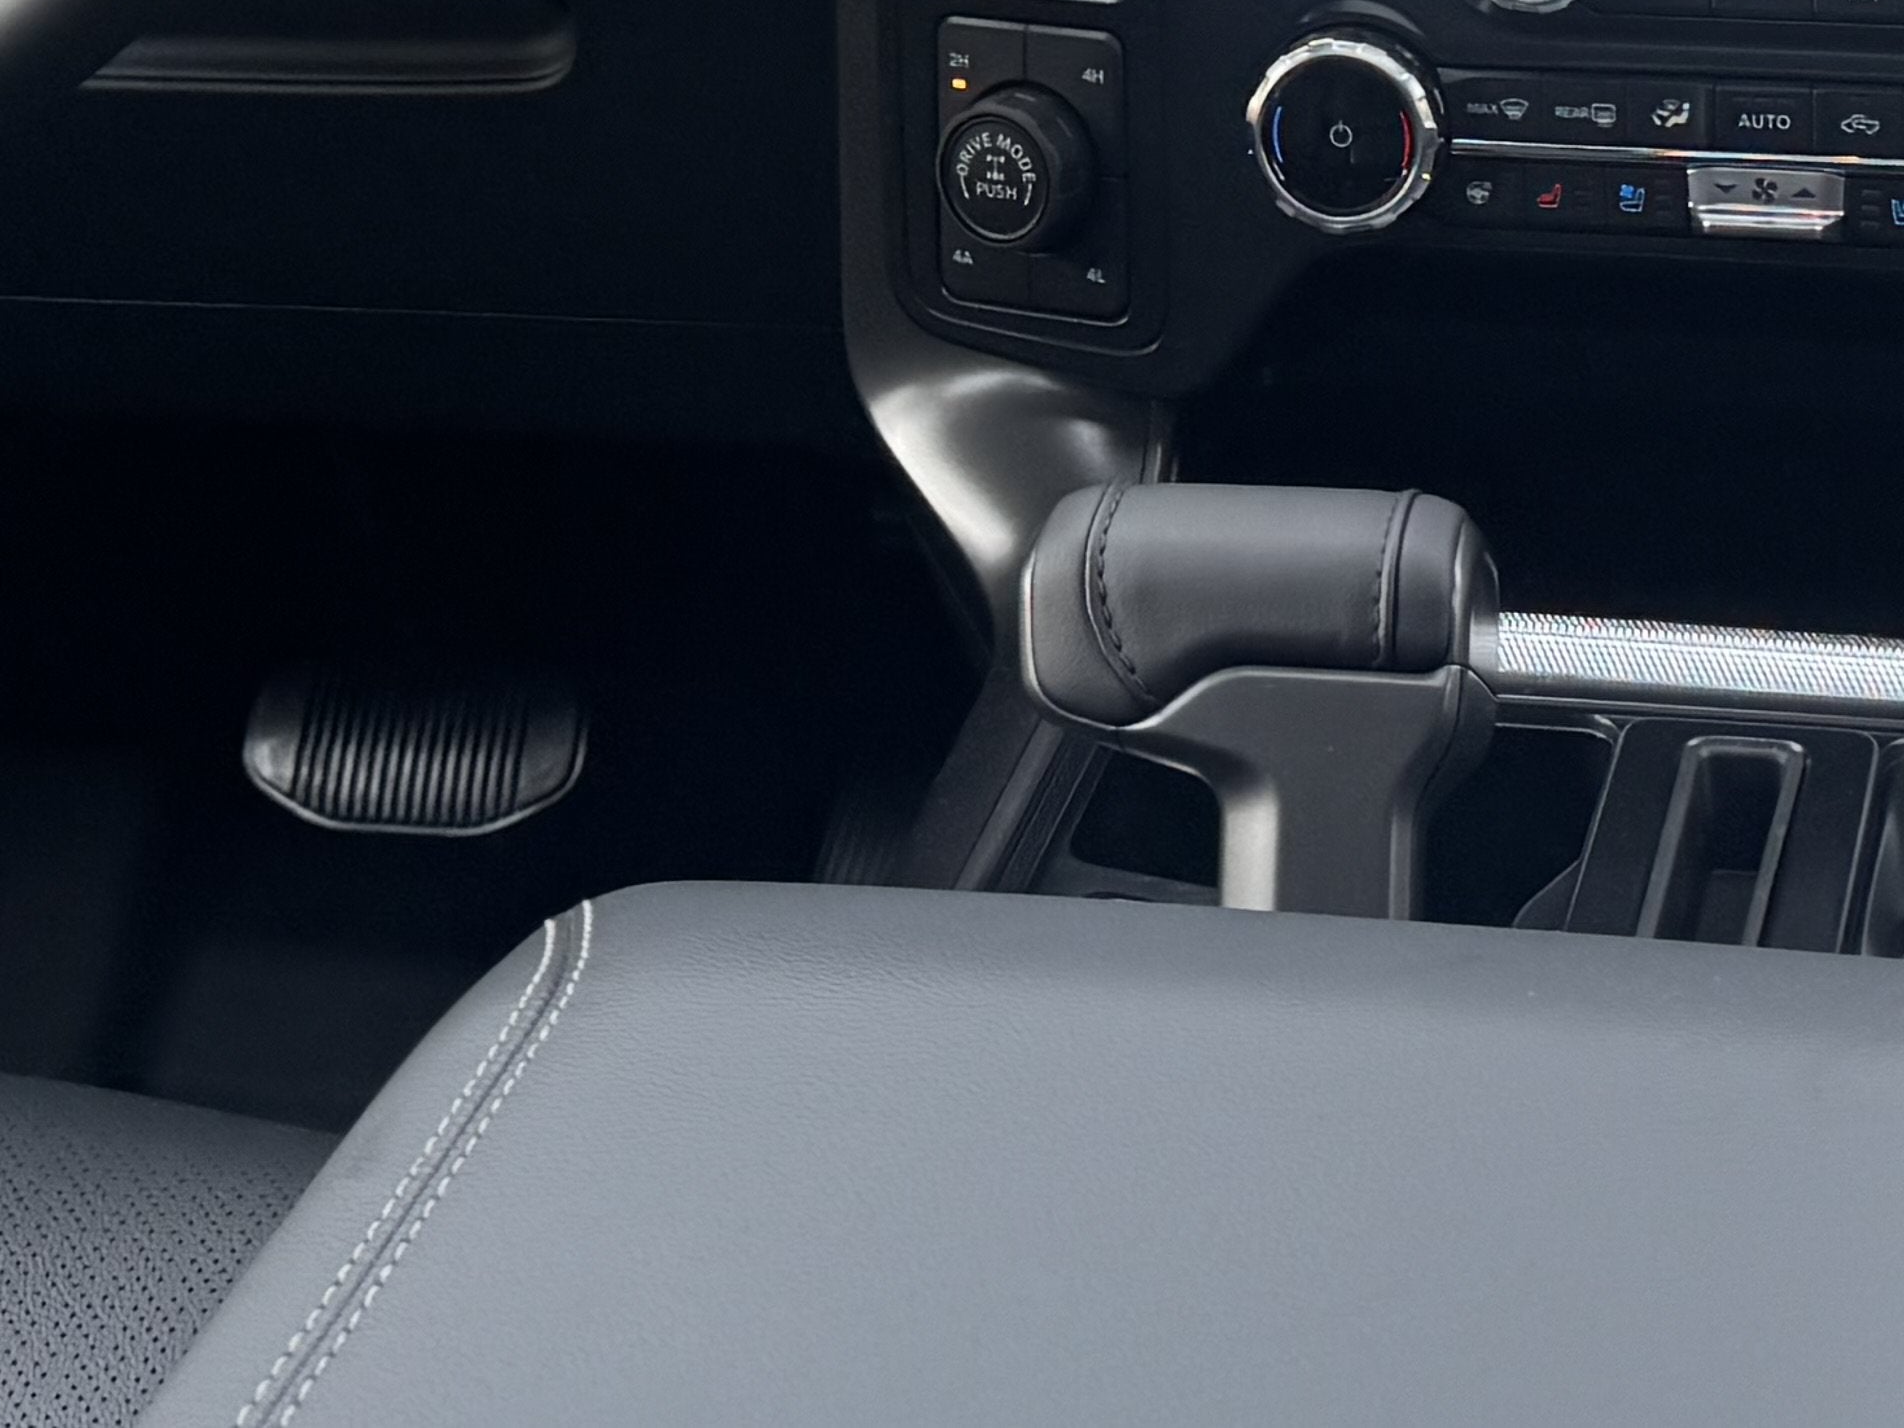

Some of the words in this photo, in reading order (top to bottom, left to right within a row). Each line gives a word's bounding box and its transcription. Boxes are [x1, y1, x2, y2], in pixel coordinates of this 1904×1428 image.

[1081, 67, 1105, 85] 4H
[1738, 113, 1792, 131] AUTO
[956, 131, 992, 177] DRIVE
[997, 133, 1037, 183] MODE
[976, 181, 1017, 201] PUSH
[952, 249, 974, 265] 4A
[1086, 267, 1106, 284] 4L
